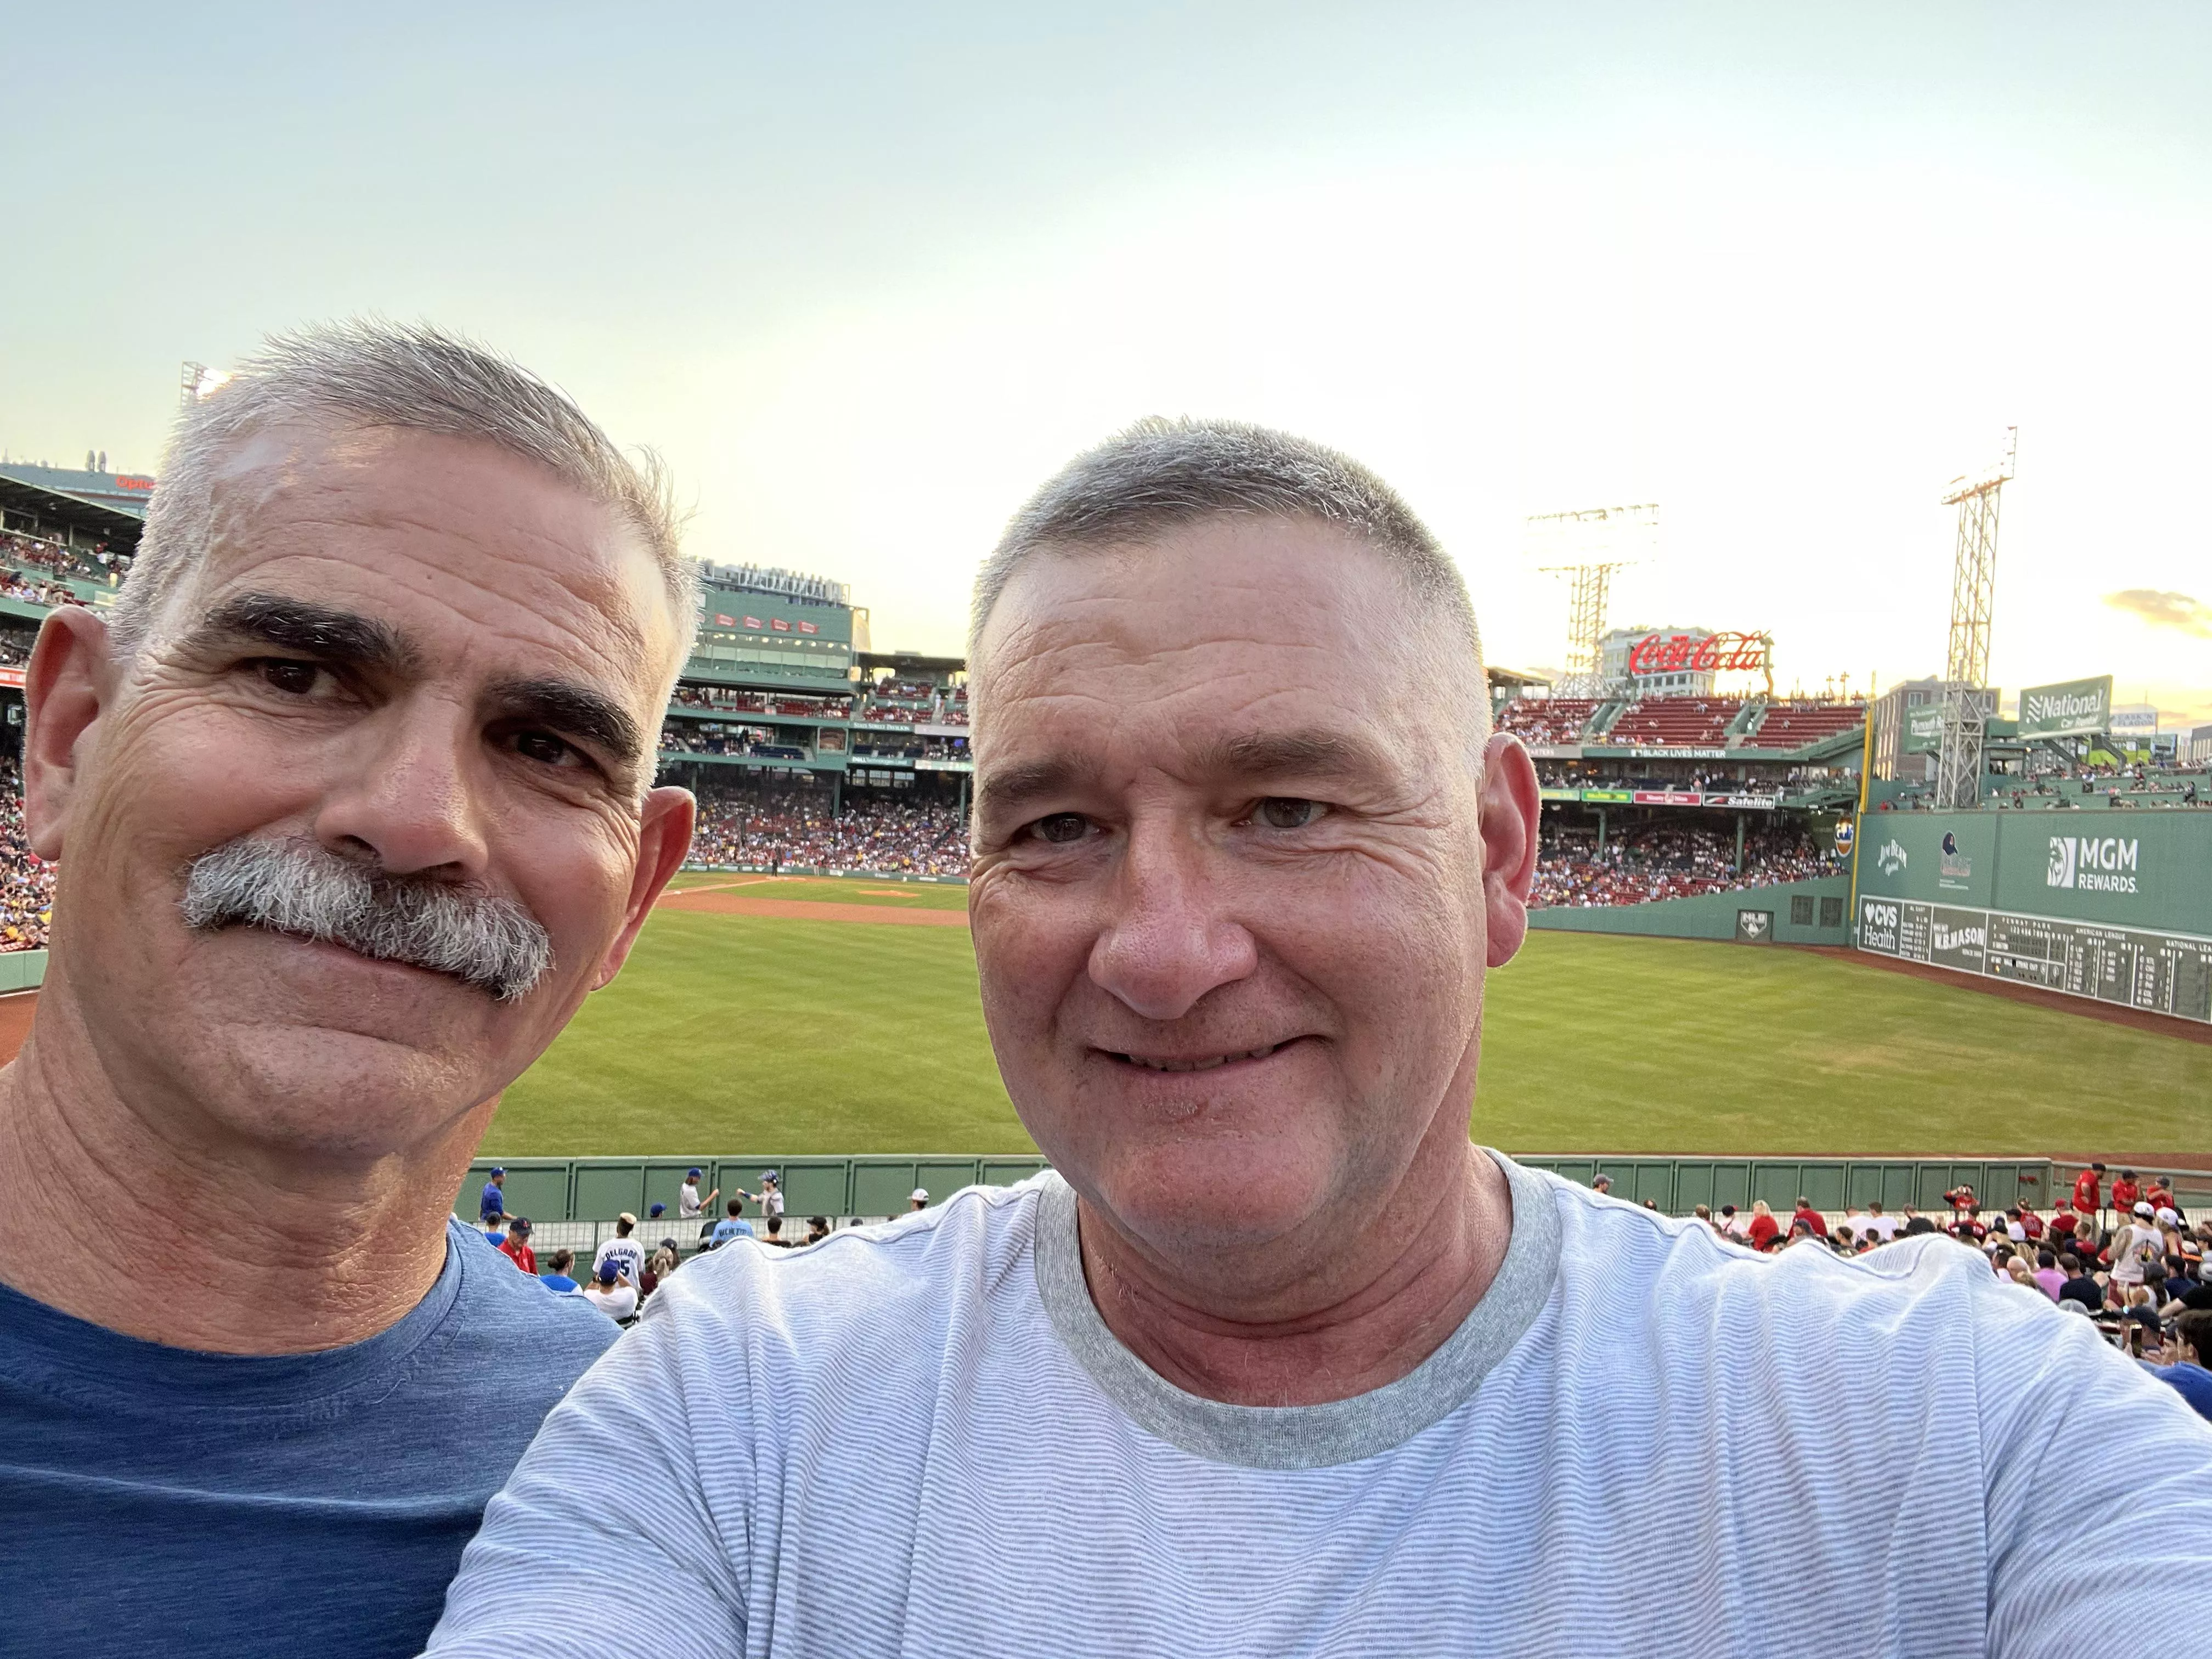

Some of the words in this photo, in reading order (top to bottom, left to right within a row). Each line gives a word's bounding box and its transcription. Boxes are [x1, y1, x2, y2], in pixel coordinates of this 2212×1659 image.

[2041, 689, 2102, 719] National
[1643, 749, 1668, 757] BLACK
[1694, 749, 1726, 758] MATTER
[1728, 797, 1773, 807] Safelite
[2080, 837, 2138, 871] MGM
[1875, 904, 1898, 928] CVS
[1864, 924, 1895, 950] Health
[2166, 939, 2197, 951] NATIONAL
[605, 1248, 637, 1260] DELGADO
